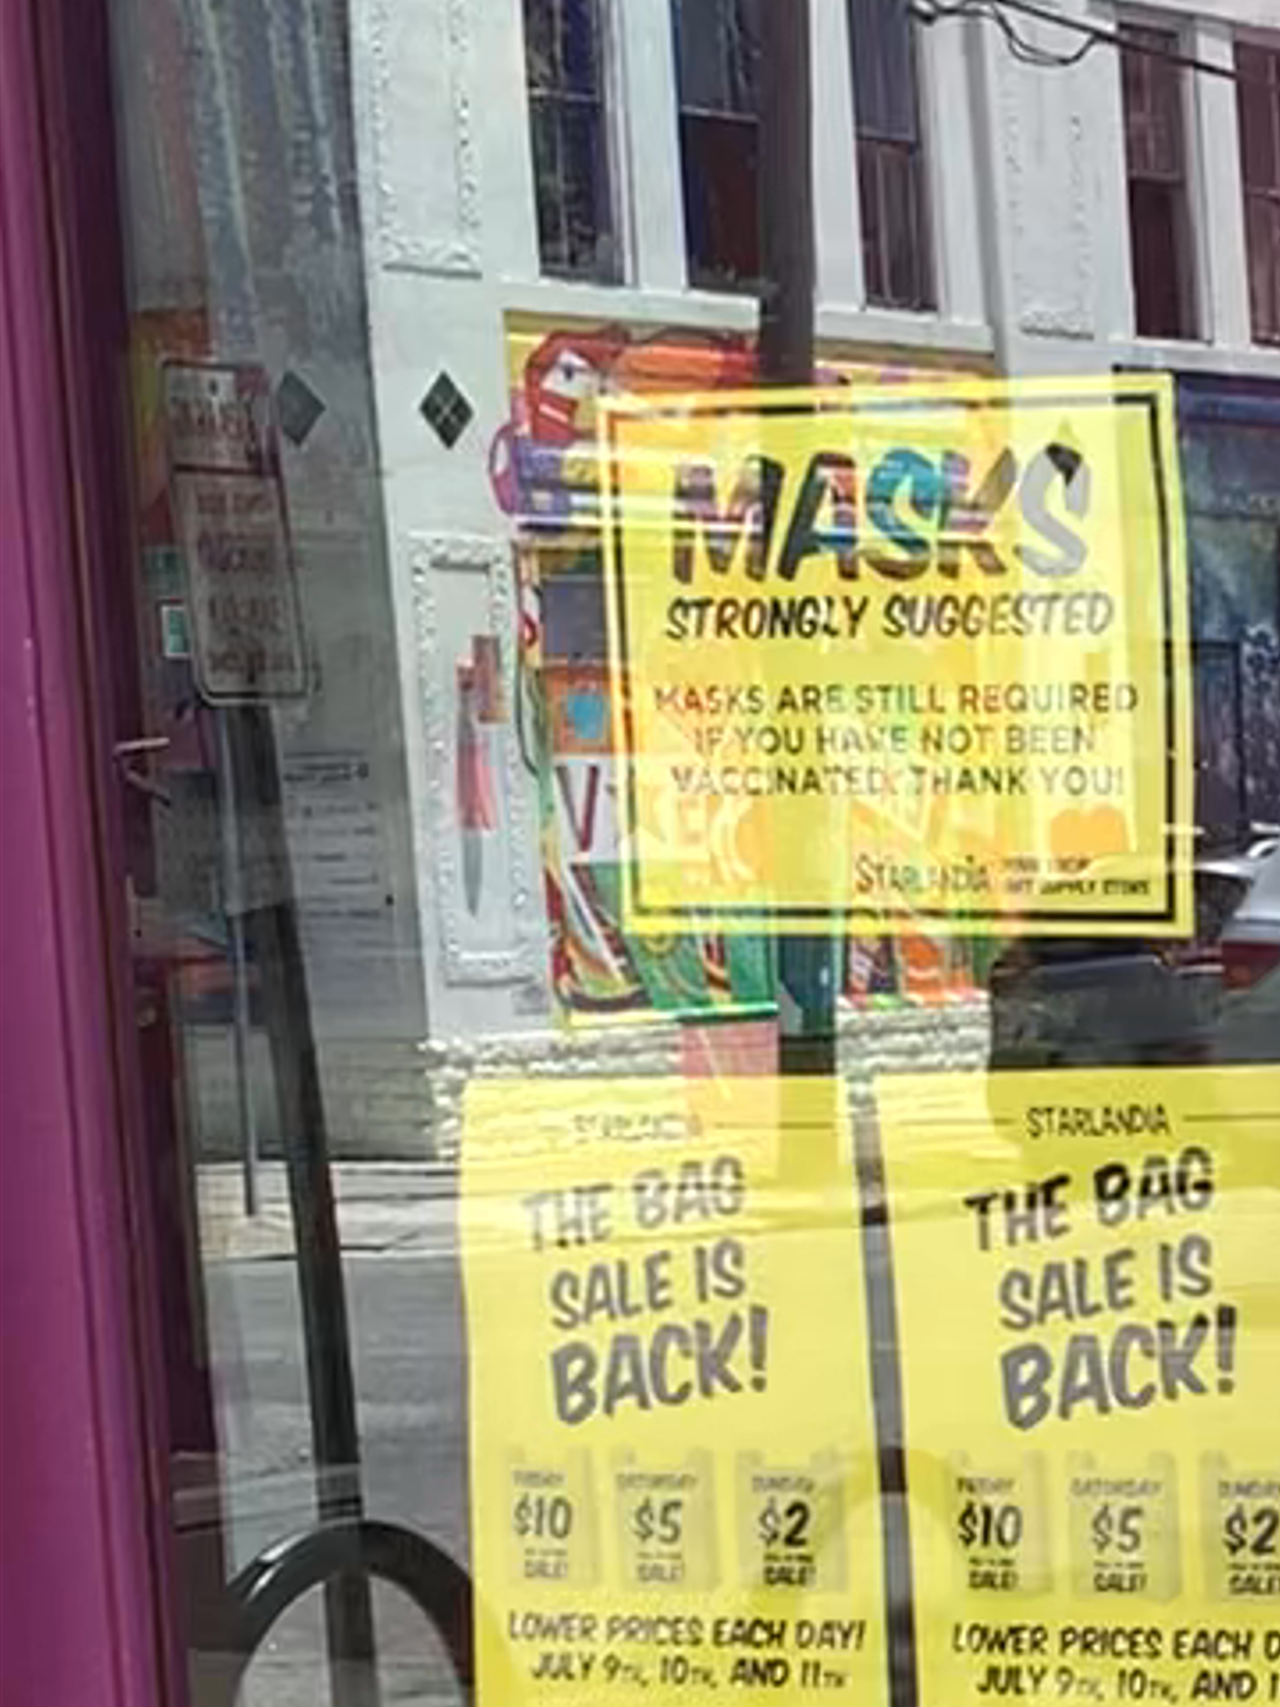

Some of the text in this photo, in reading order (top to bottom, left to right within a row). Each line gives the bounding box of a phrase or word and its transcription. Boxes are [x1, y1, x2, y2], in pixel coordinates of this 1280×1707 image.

[671, 443, 1092, 585] MASKS
[666, 591, 1114, 642] STRONGLY SUGGESTED
[655, 682, 1139, 715] MASKS ARE STILL REQUIRED
[696, 726, 1094, 754] IF YOU HAVE NOT BEEN
[909, 765, 1029, 795] THANK
[1040, 765, 1124, 795] YOU!
[1026, 1104, 1172, 1138] STARLANDIA
[521, 1154, 745, 1252] THE BAG
[962, 1145, 1214, 1252] THE BAG
[550, 1236, 746, 1332] SALE IS
[1000, 1234, 1213, 1332] SALE IS
[550, 1304, 769, 1427] BACK!
[1000, 1303, 1238, 1430] BACK!
[513, 1491, 574, 1539] $10
[632, 1495, 684, 1545] $5
[758, 1496, 811, 1548] $2
[957, 1500, 1024, 1549] $10
[1091, 1502, 1146, 1554] $5
[1222, 1503, 1280, 1557] $2
[508, 1611, 867, 1651] LOWER PRICES EACH DAY!
[951, 1622, 1049, 1656] LOWER
[1058, 1626, 1164, 1659] PRICES
[1172, 1628, 1255, 1660] EACH
[531, 1652, 596, 1681] JULY
[729, 1658, 790, 1687] AND
[976, 1666, 1049, 1696] JULY
[1190, 1669, 1258, 1701] AND
